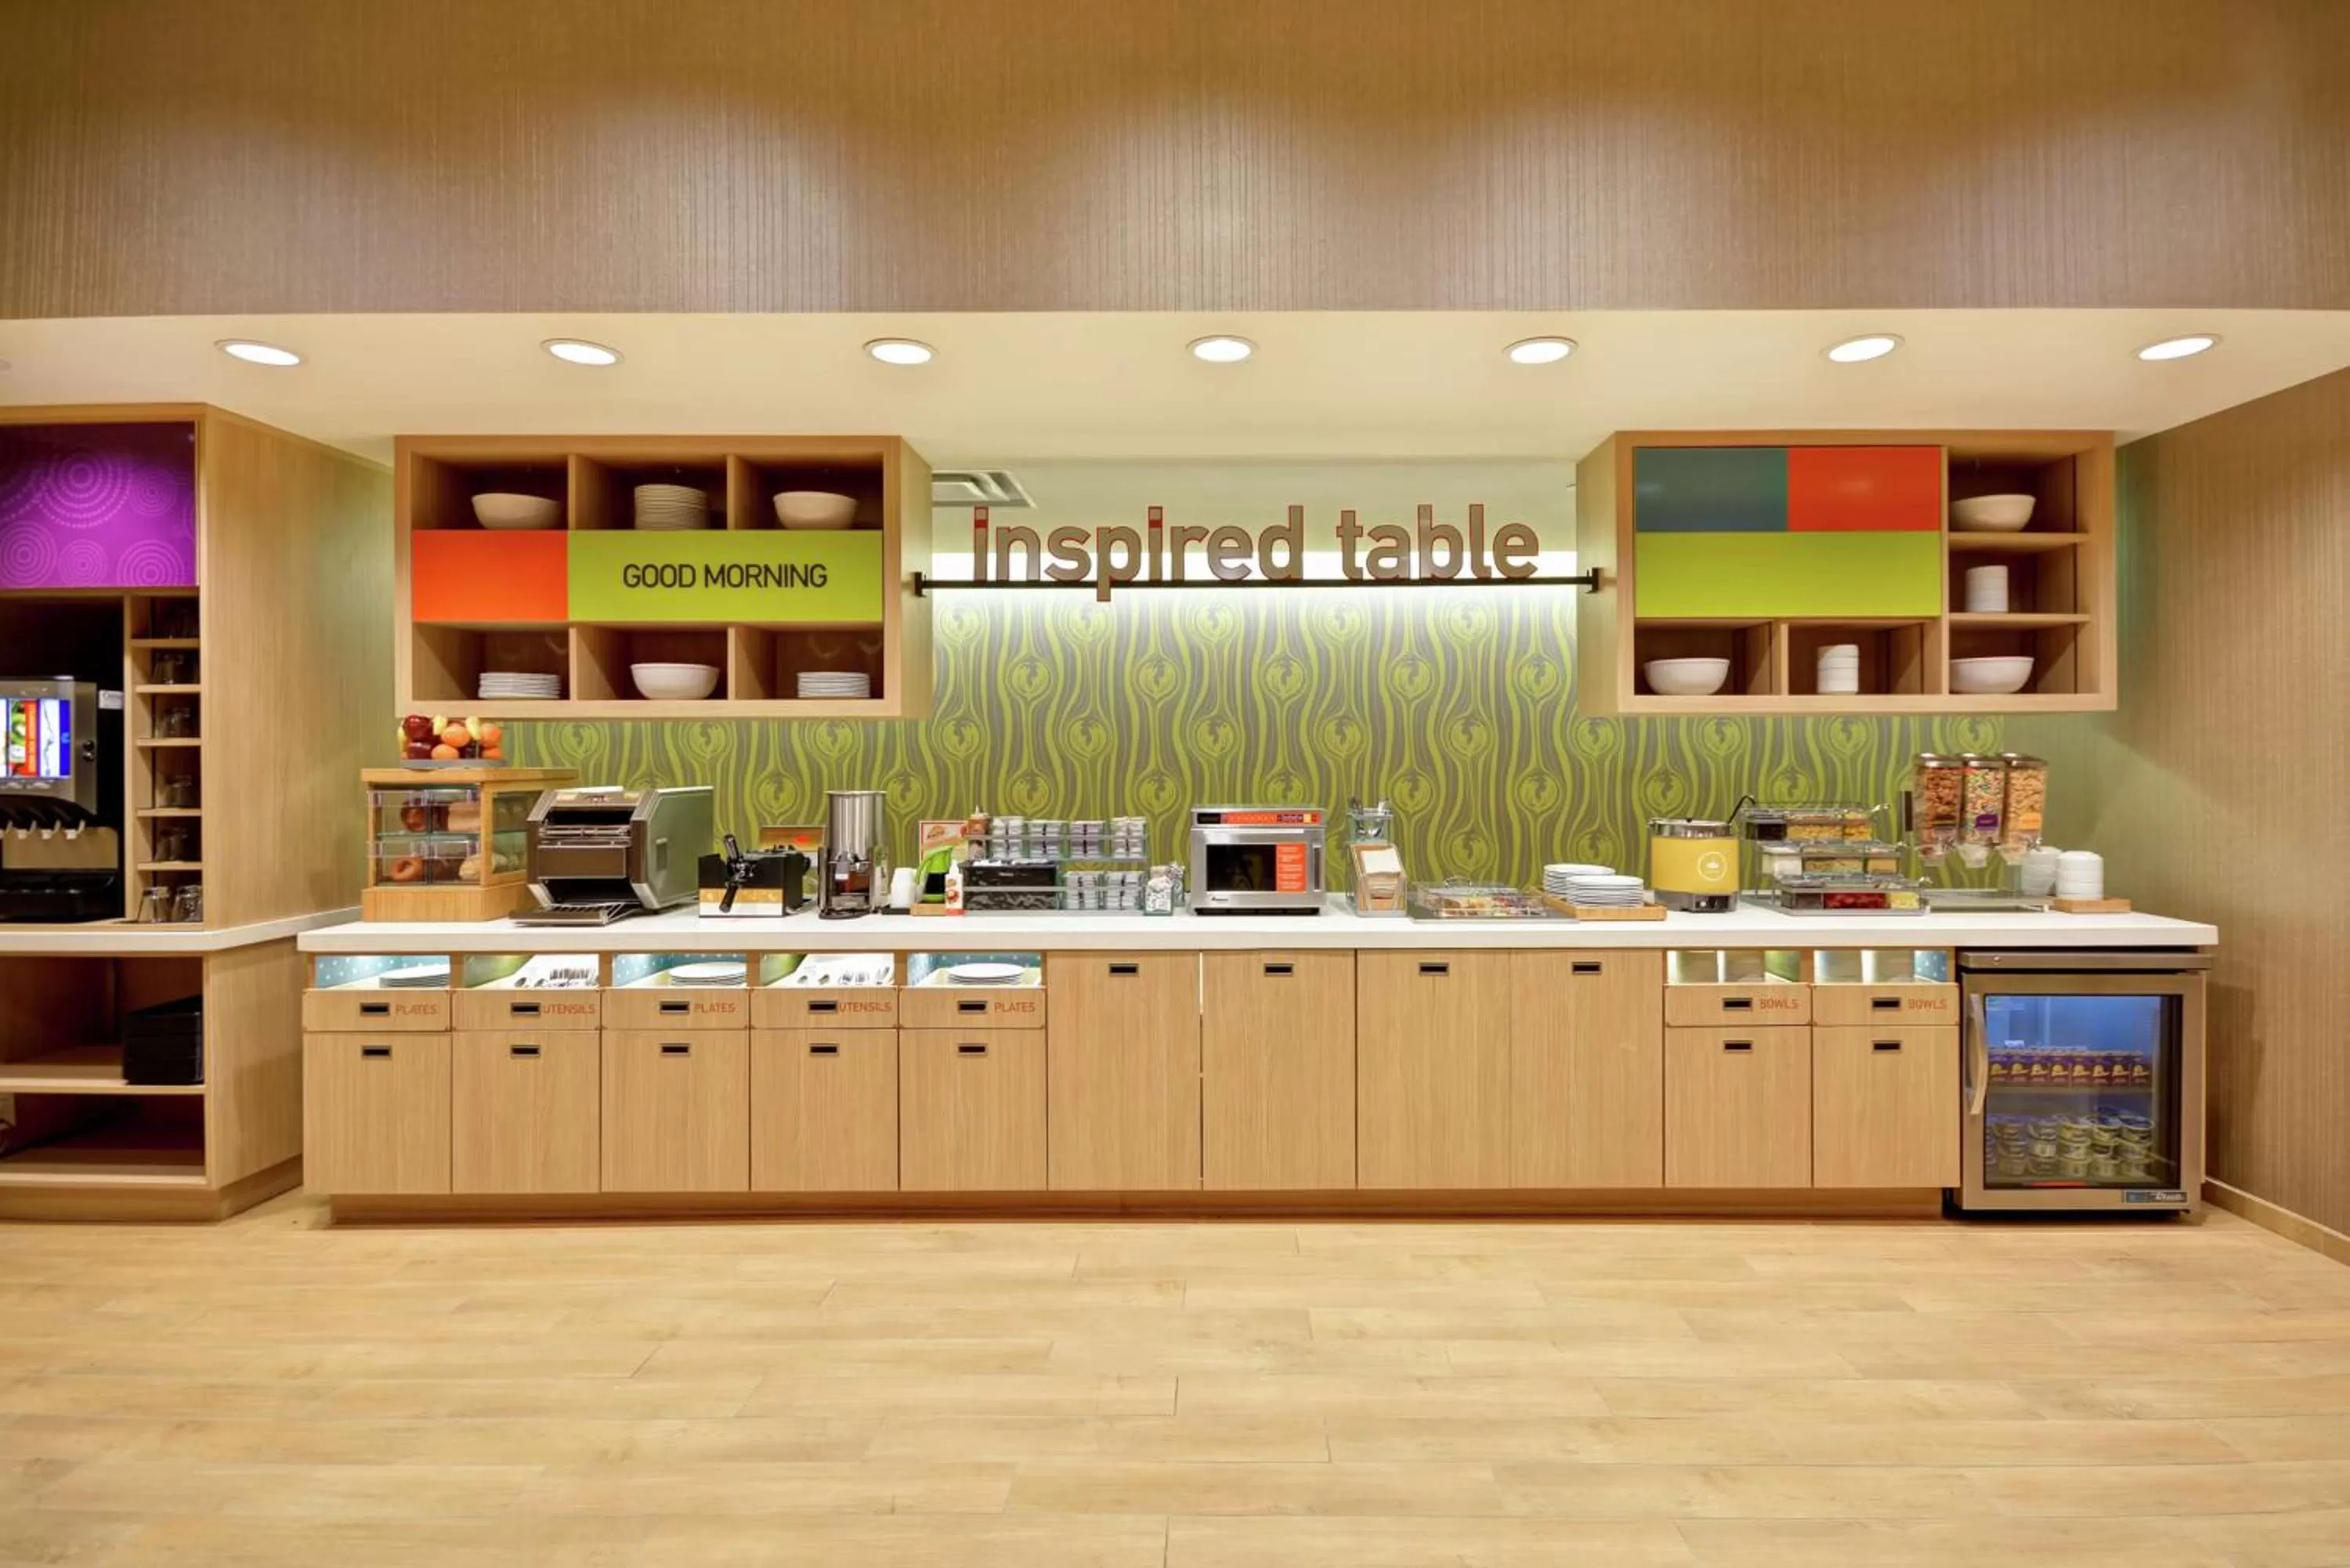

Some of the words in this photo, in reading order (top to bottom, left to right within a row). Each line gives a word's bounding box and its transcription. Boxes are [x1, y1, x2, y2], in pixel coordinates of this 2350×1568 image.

[974, 505, 1303, 602] inspired
[1336, 504, 1539, 580] table
[623, 563, 696, 588] GOOD
[704, 563, 828, 588] MORNING
[395, 1003, 439, 1016] PLATES
[543, 1003, 596, 1015] UTENSILS
[694, 1002, 736, 1013] PLATES
[839, 1002, 892, 1013] UTENSILS
[994, 1001, 1036, 1013] PLATES
[1759, 999, 1799, 1010] BOWLS
[1907, 999, 1947, 1010] BOWLS
